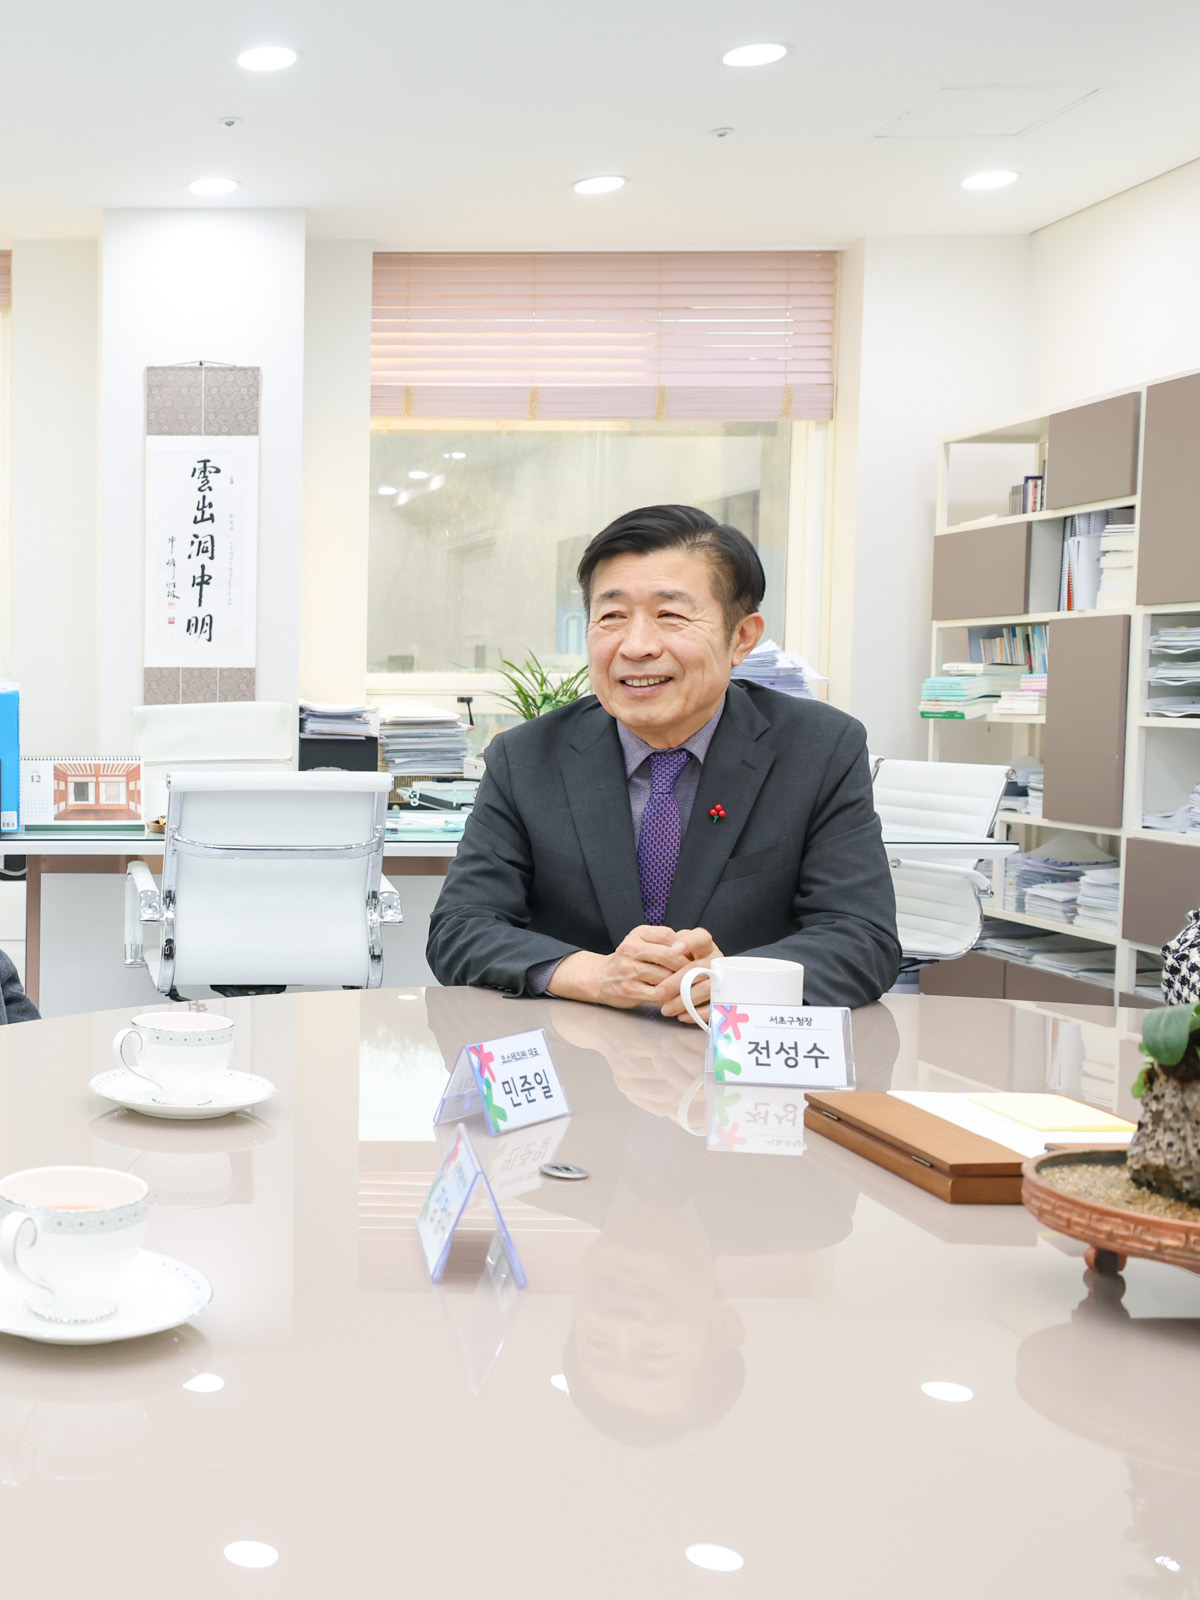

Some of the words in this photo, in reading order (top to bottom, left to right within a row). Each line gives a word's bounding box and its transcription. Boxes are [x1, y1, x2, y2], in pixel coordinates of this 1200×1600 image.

[186, 459, 221, 643] 雲出洞中明
[31, 775, 41, 783] 12
[768, 1015, 813, 1027] 서초구청장
[747, 1040, 830, 1069] 전성수
[501, 1069, 554, 1108] 민준일
